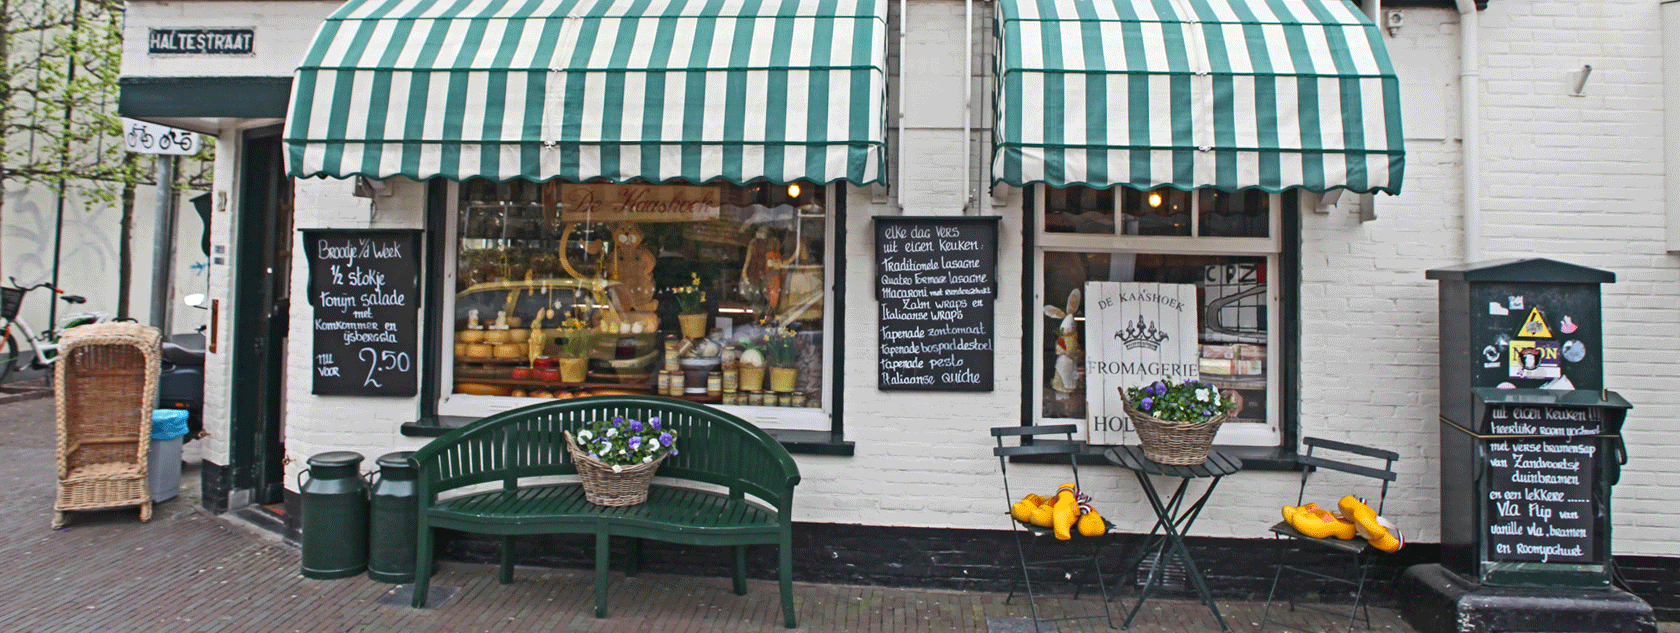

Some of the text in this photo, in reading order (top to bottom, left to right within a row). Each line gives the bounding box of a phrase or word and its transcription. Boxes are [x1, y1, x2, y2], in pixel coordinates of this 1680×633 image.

[150, 31, 252, 50] HALTESTRAAT
[568, 187, 714, 213] De Kaashoek
[885, 226, 907, 239] elke
[911, 226, 930, 238] dag
[318, 239, 357, 267] Broodje
[883, 241, 898, 253] uit
[905, 241, 934, 252] eigen
[942, 256, 980, 269] lasagne
[348, 266, 386, 293] stokje
[948, 271, 988, 285] lasagne
[360, 288, 405, 307] salade
[929, 288, 943, 297] met
[902, 299, 931, 310] Zalm
[971, 300, 984, 308] en
[1097, 296, 1114, 310] DE
[353, 307, 374, 319] met
[881, 303, 929, 321] Italiaanse
[384, 322, 397, 332] en
[927, 322, 987, 336] zontomaat
[358, 347, 411, 388] 2.50
[929, 354, 964, 369] pesto
[1087, 361, 1198, 377] FROMAGERIE
[882, 371, 935, 385] Italiaanse
[1493, 405, 1508, 419] uit
[1513, 406, 1541, 419] eigen
[1490, 440, 1510, 452] met
[1512, 443, 1541, 452] verse
[1490, 453, 1580, 472] van Zandvoortse
[1511, 470, 1580, 485] duinbramen
[1489, 491, 1502, 500] en
[1504, 491, 1522, 500] een
[1529, 502, 1552, 522] Flip
[1559, 511, 1579, 519] van
[1490, 521, 1523, 535] vanille
[1549, 524, 1587, 538] bramen
[1496, 543, 1511, 554] en
